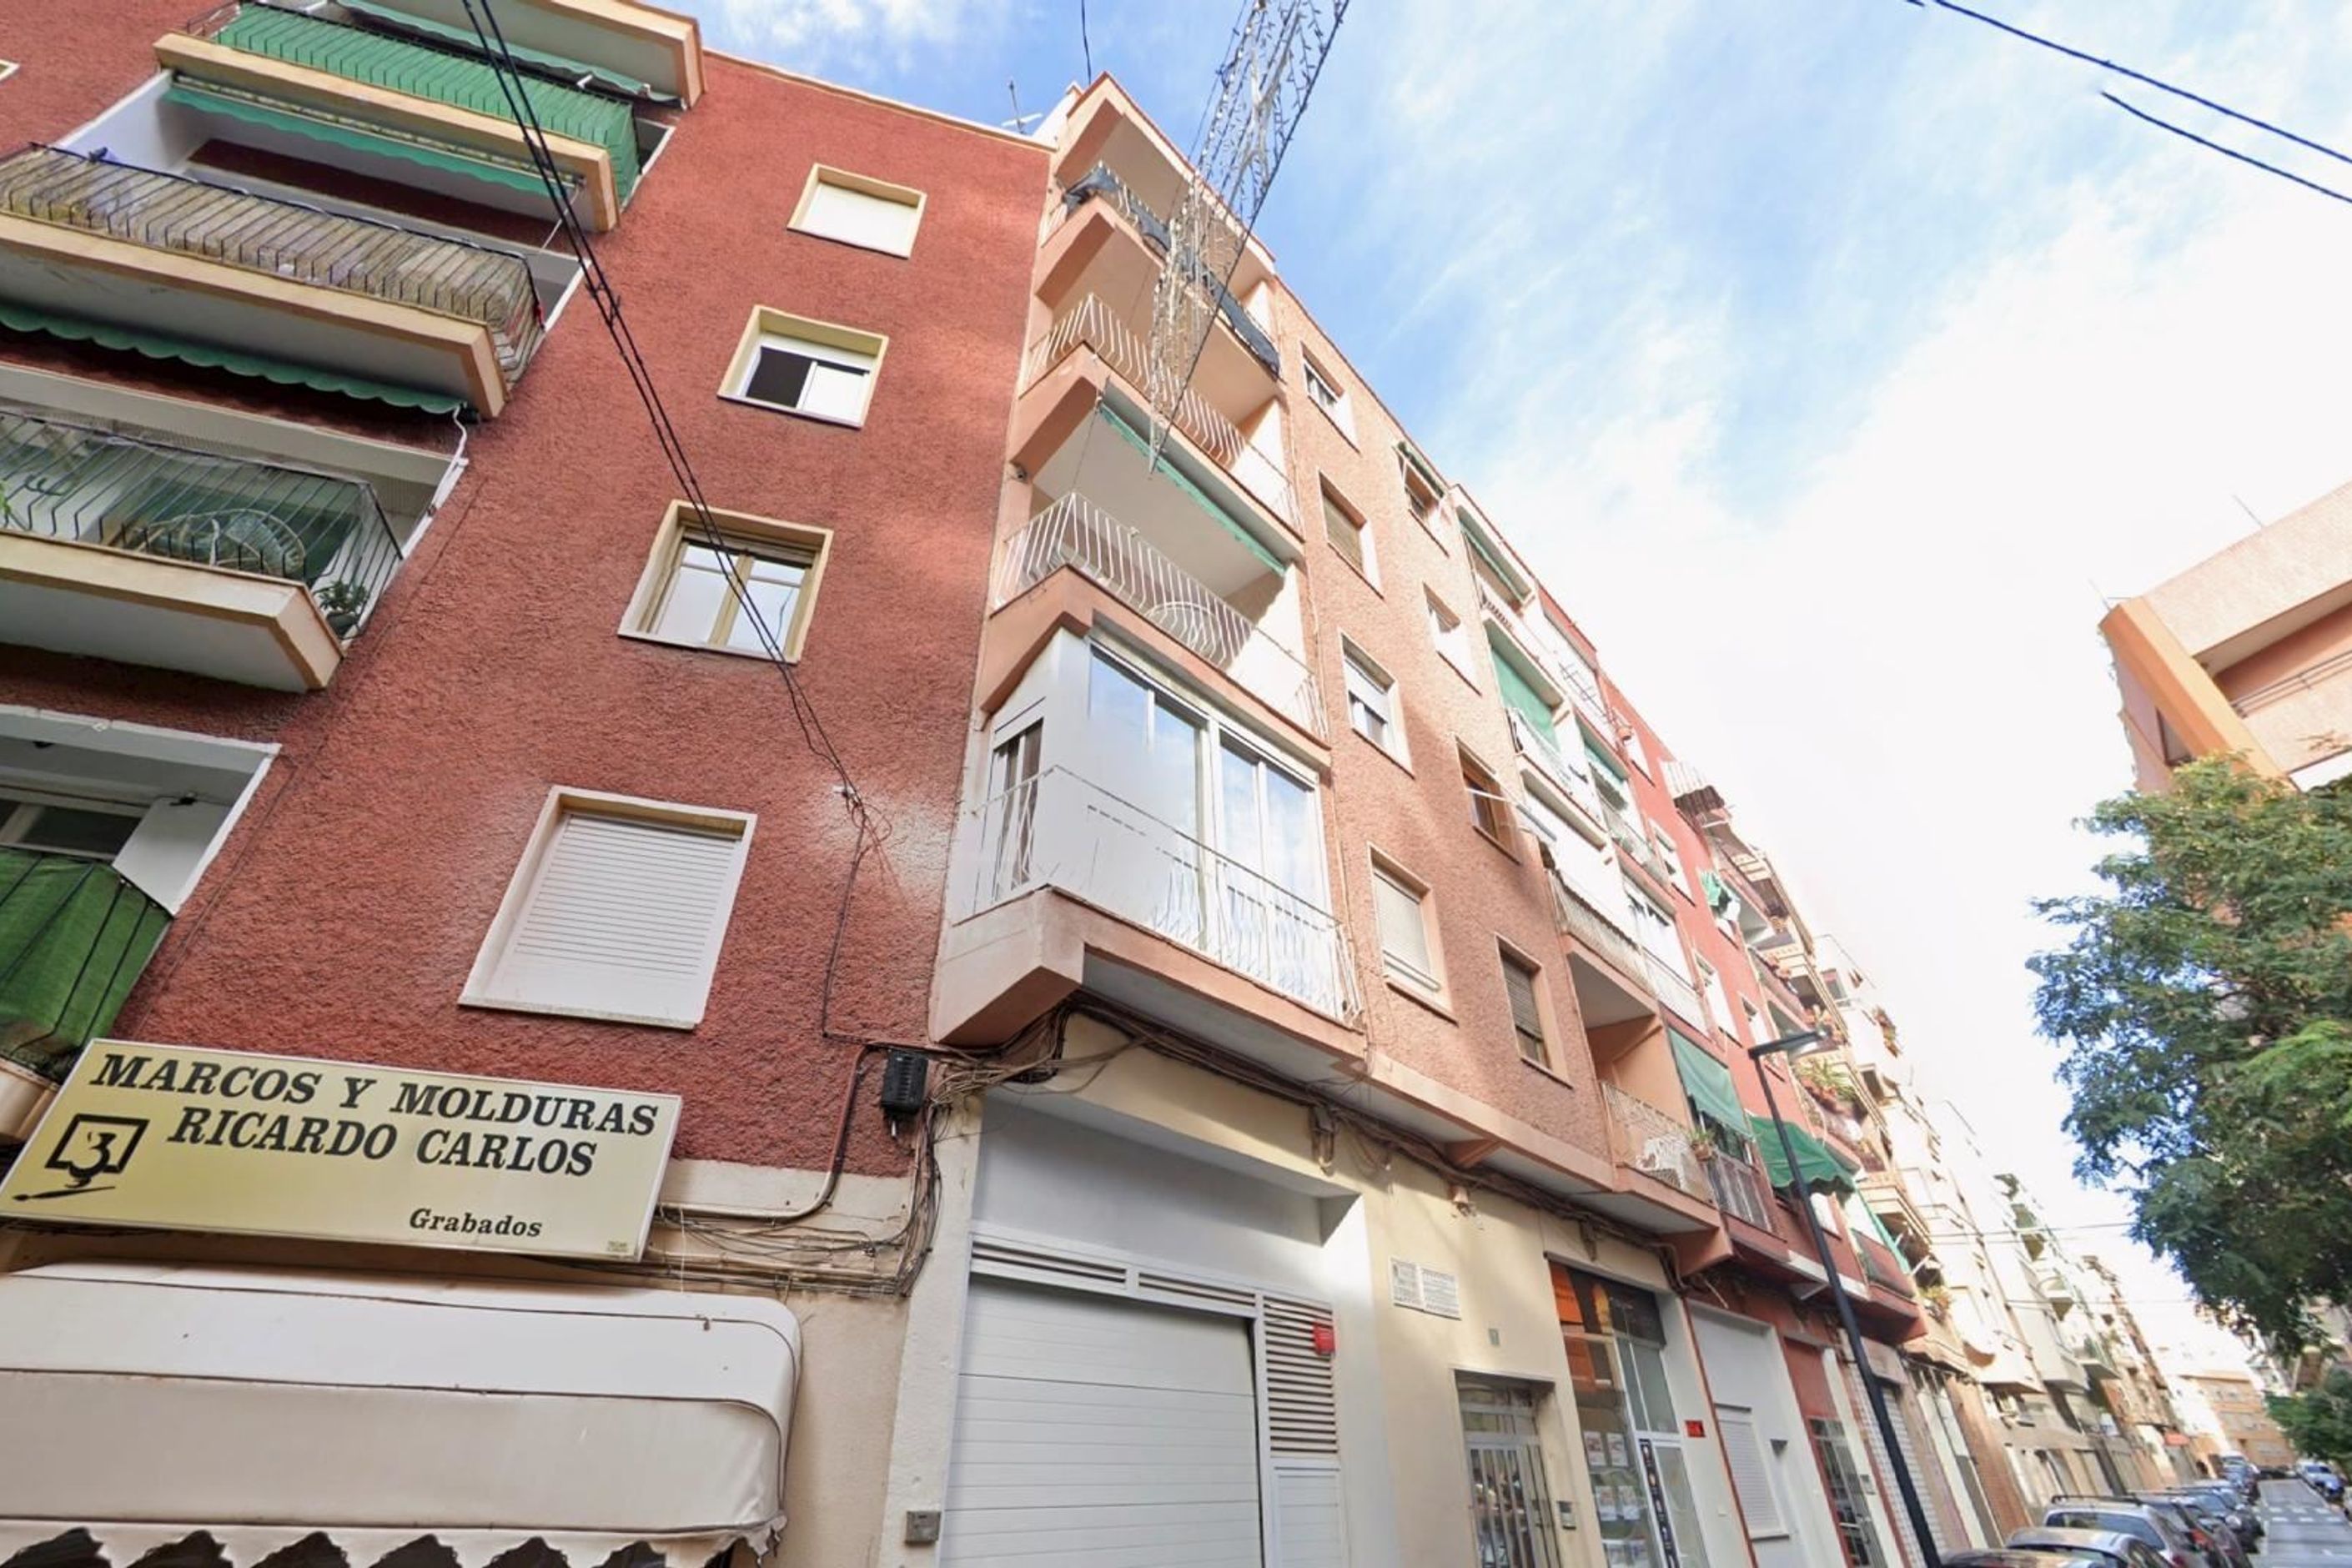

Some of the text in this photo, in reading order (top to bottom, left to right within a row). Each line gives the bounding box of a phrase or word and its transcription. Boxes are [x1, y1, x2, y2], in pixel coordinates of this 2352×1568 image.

[88, 1053, 659, 1137] MARCOS Y MOLDURAS
[166, 1106, 598, 1177] RICARDO CARLOS
[409, 1208, 543, 1238] Grabados
